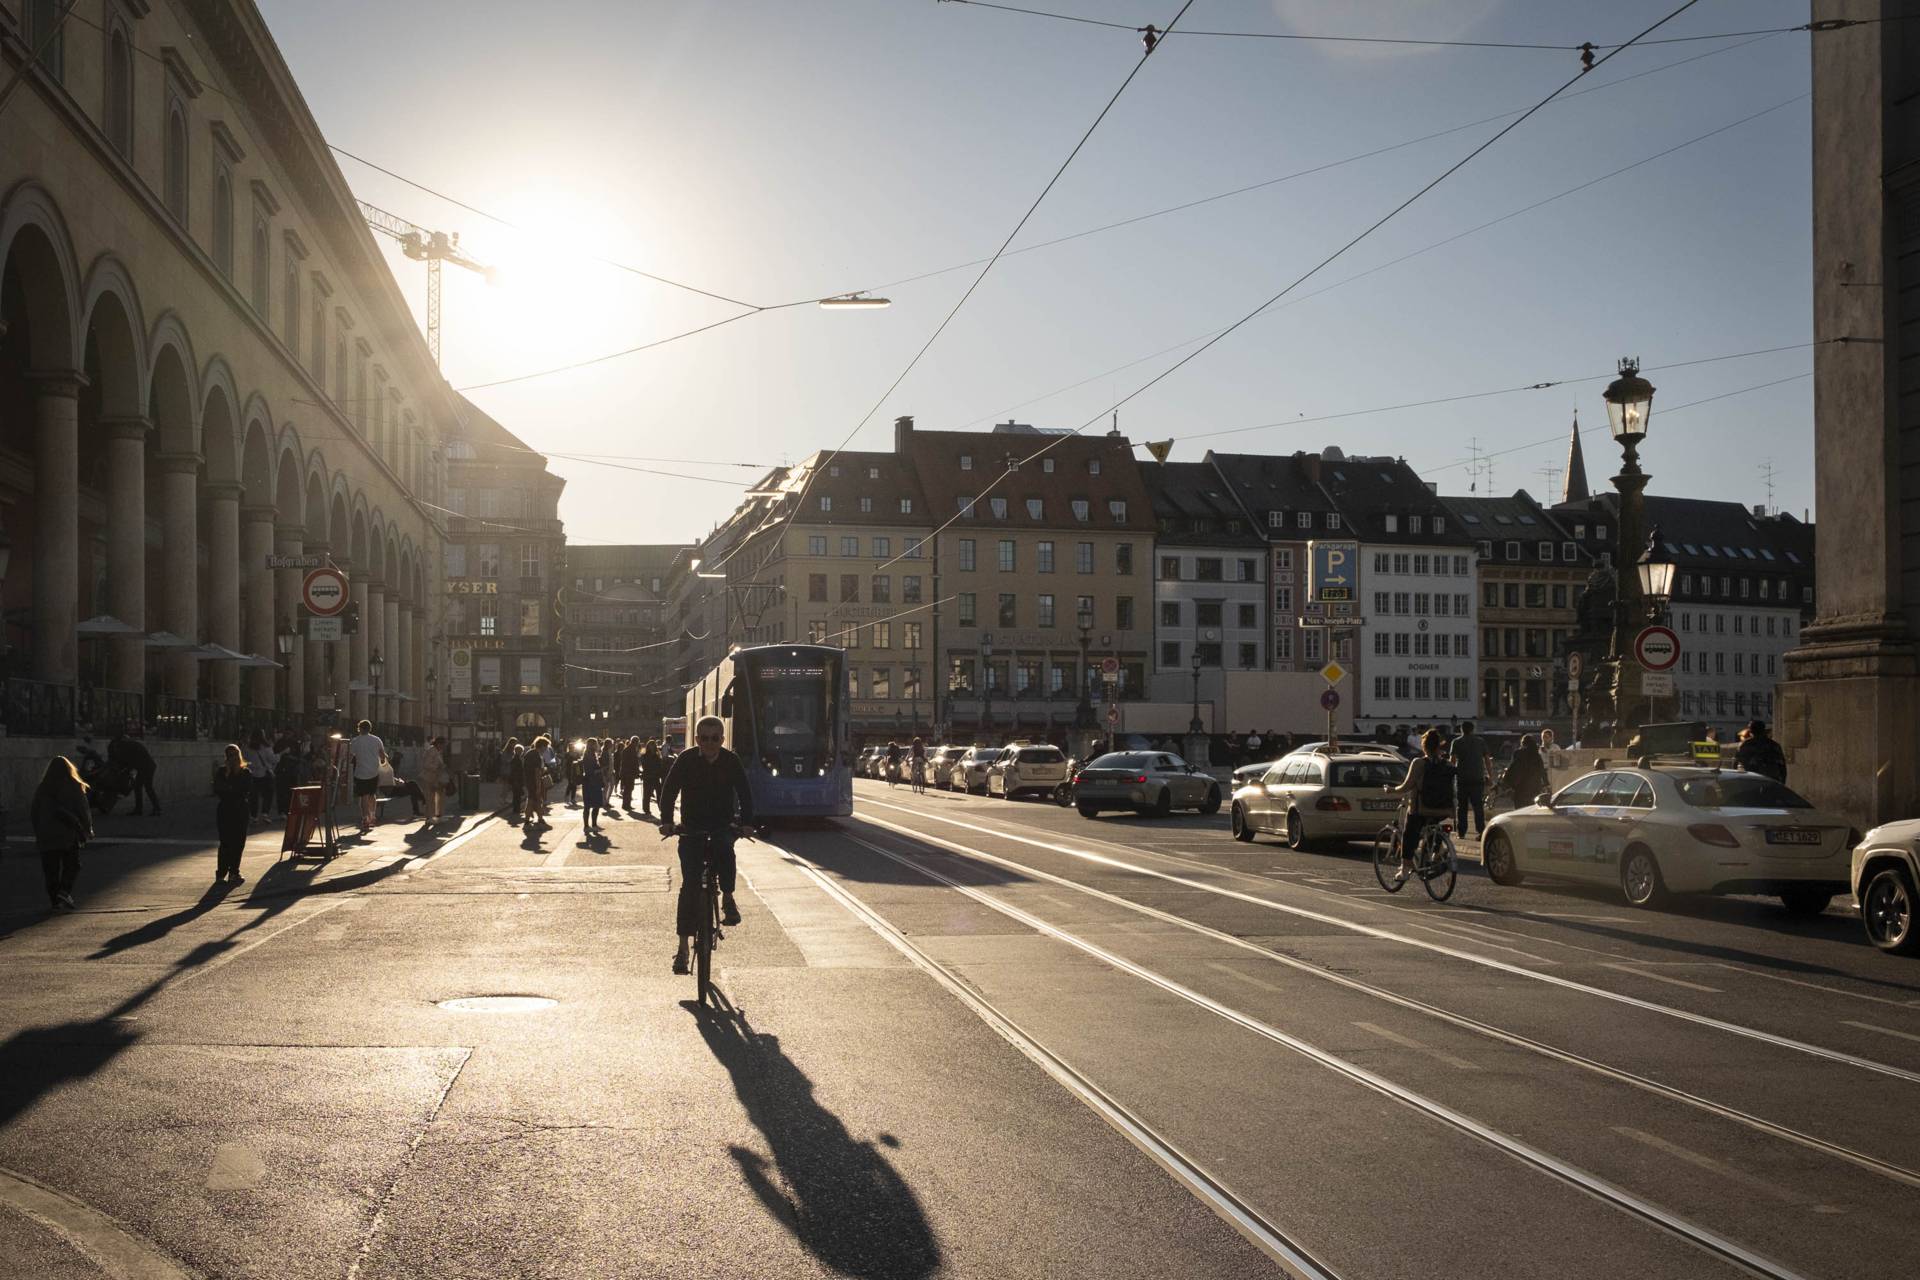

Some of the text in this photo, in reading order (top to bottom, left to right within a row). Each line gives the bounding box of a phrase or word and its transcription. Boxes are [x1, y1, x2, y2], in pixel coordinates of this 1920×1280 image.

[1328, 551, 1345, 574] P
[1306, 616, 1363, 625] Max-Joseph-Platz
[1408, 663, 1440, 671] BOGNER
[1696, 745, 1720, 753] TAXI
